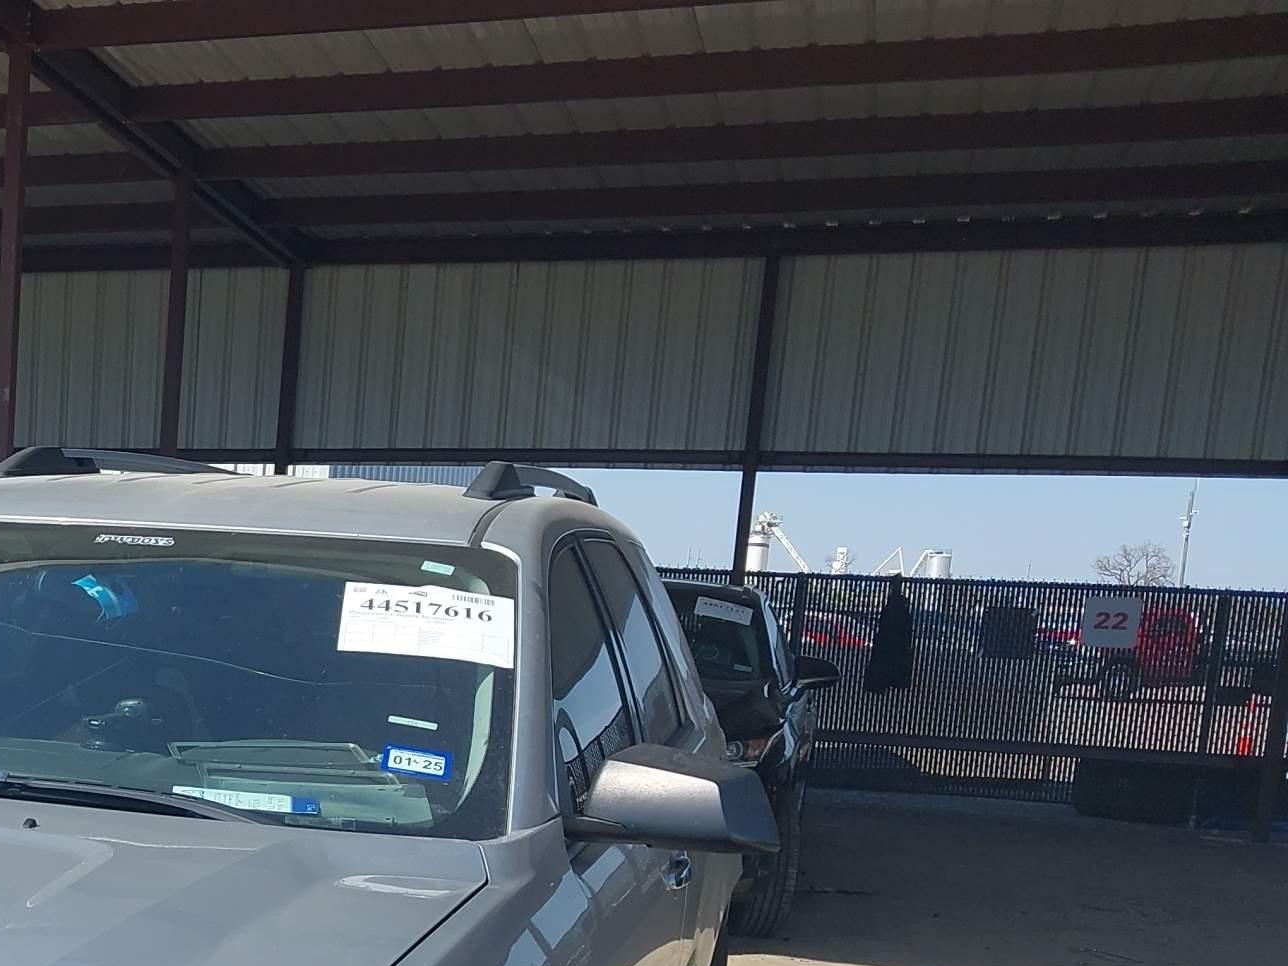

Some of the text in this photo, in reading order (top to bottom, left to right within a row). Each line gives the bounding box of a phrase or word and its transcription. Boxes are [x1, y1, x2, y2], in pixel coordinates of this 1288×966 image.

[359, 597, 494, 623] 44517616
[1093, 611, 1129, 630] 22
[393, 755, 444, 771] 01 25
